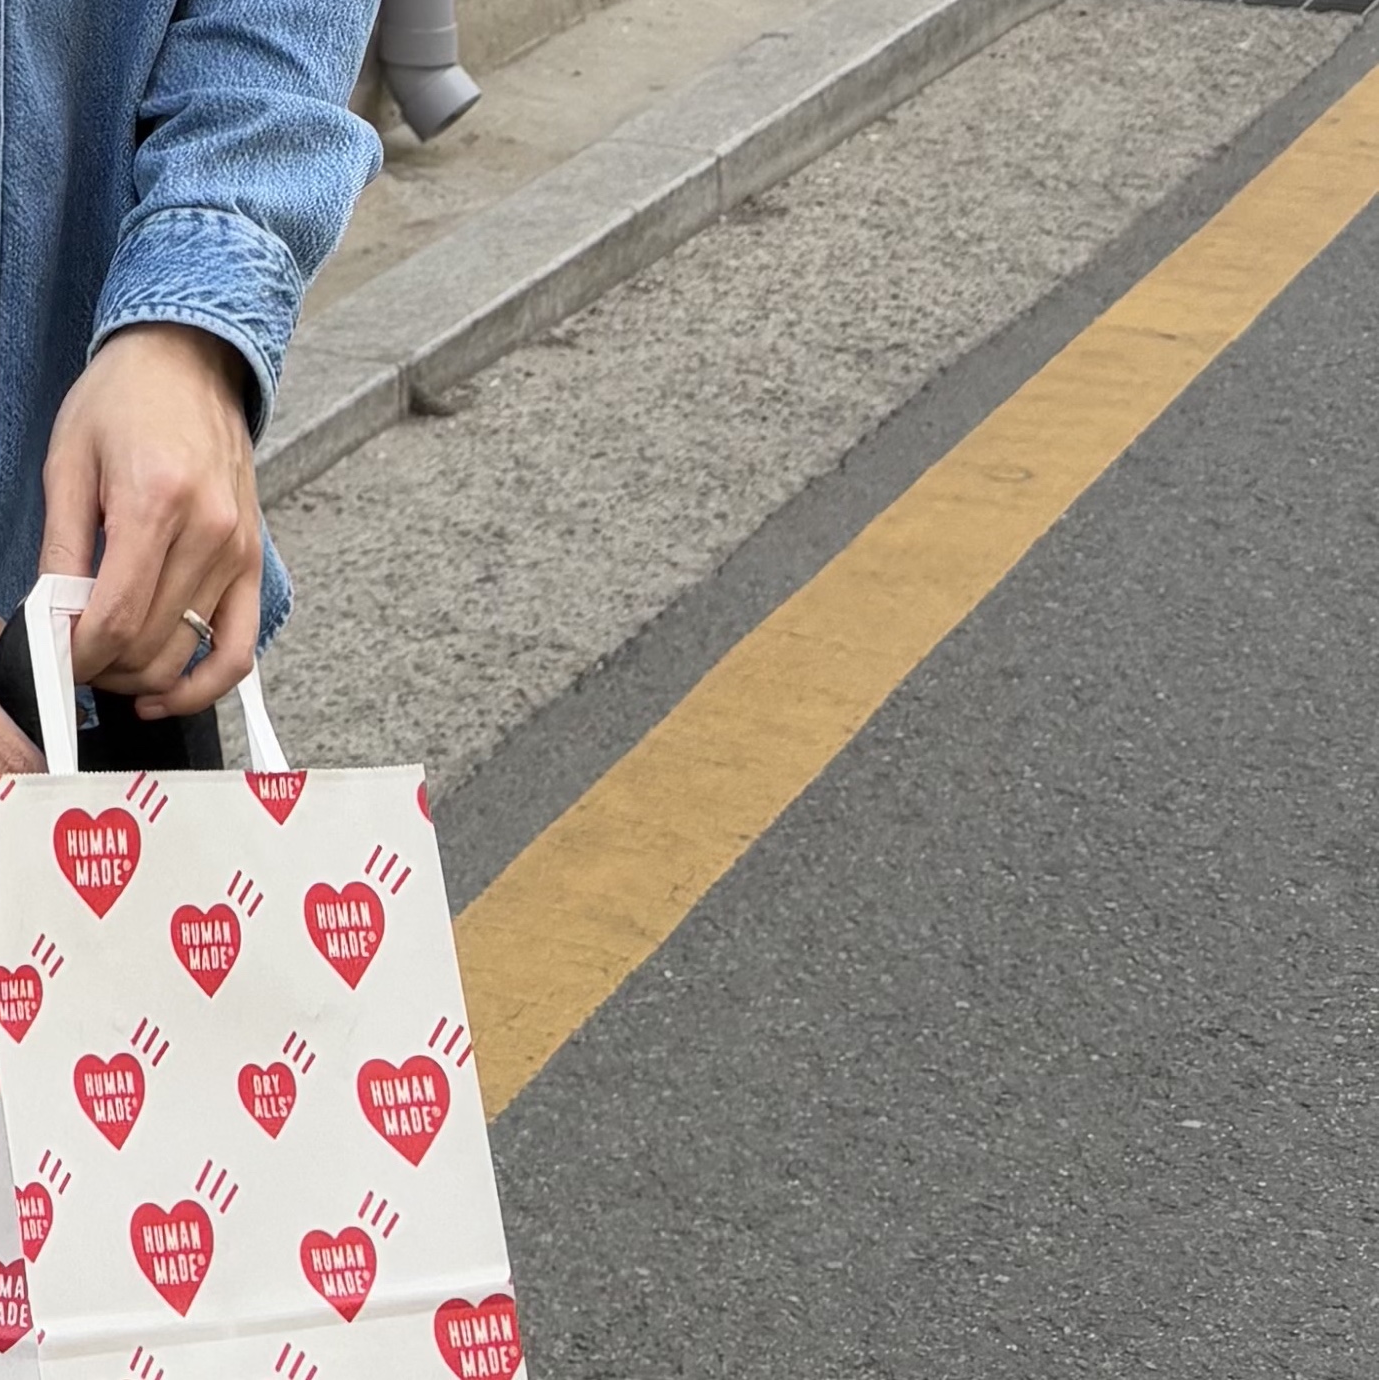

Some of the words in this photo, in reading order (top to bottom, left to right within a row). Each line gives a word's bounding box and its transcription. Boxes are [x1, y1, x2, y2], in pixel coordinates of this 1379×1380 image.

[67, 828, 128, 857] HUMAN
[316, 901, 371, 929] HUMAN
[181, 921, 231, 946] HUMAN
[84, 1071, 135, 1097] HUMAN
[253, 1074, 280, 1096] DRY
[370, 1077, 436, 1107] HUMAN
[142, 1221, 201, 1252] HUMAN
[311, 1245, 366, 1271] HUMAN
[448, 1313, 513, 1346] HUMAN
